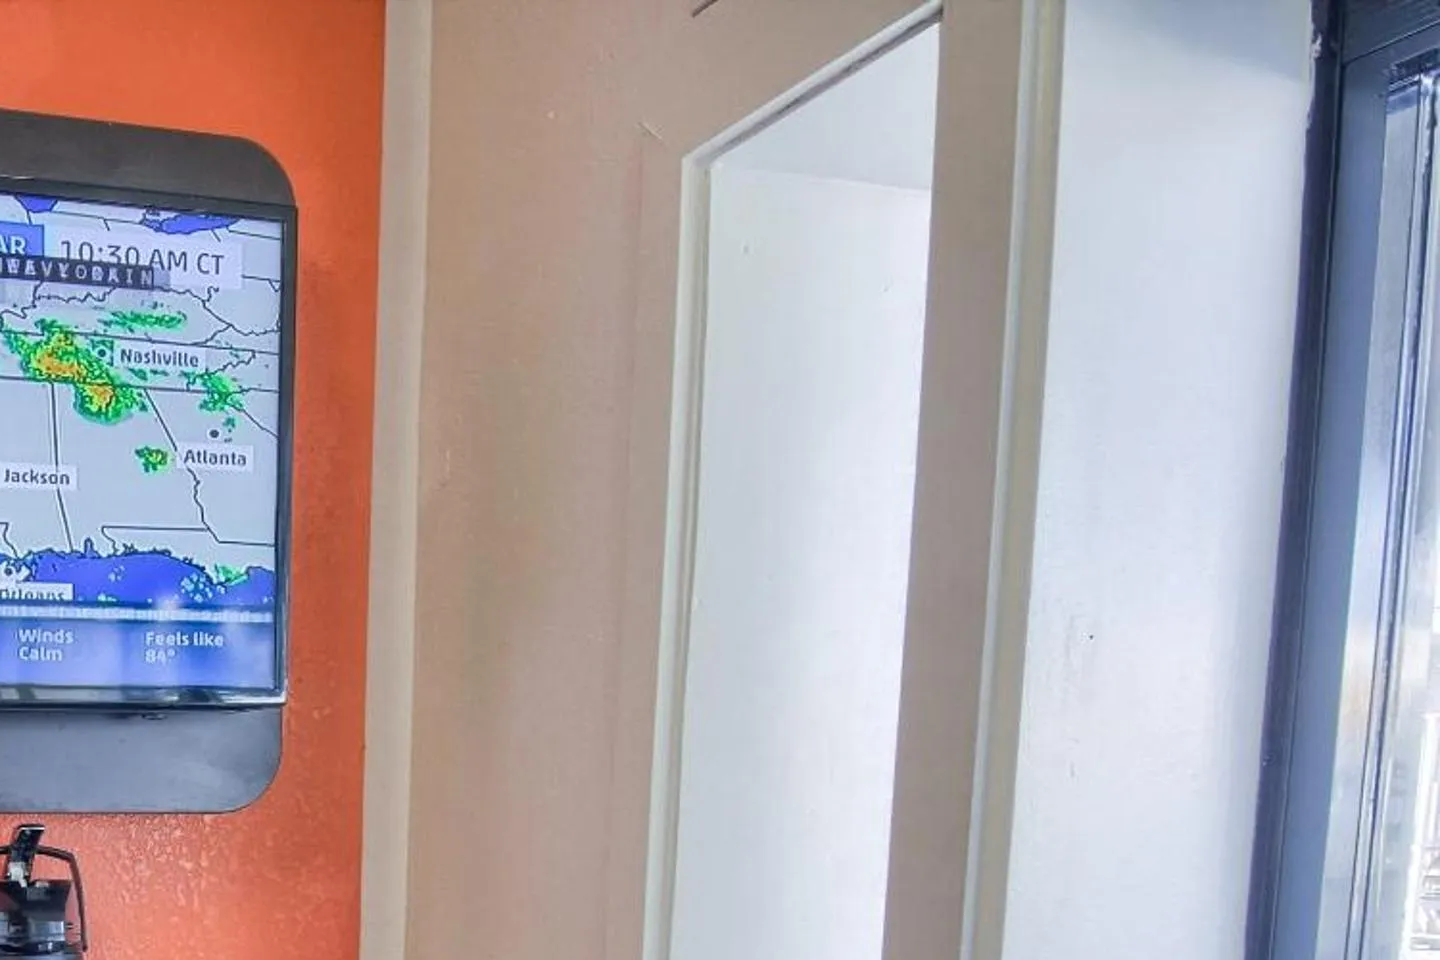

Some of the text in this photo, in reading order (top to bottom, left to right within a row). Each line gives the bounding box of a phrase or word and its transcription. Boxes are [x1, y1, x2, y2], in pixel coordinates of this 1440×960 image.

[60, 240, 225, 275] 10:30 AM CT
[120, 347, 199, 368] Nashville
[183, 448, 248, 467] Atlanta
[3, 467, 70, 486] Jackson
[17, 628, 74, 645] Winds
[145, 631, 224, 647] Feels like
[18, 646, 63, 661] Calm
